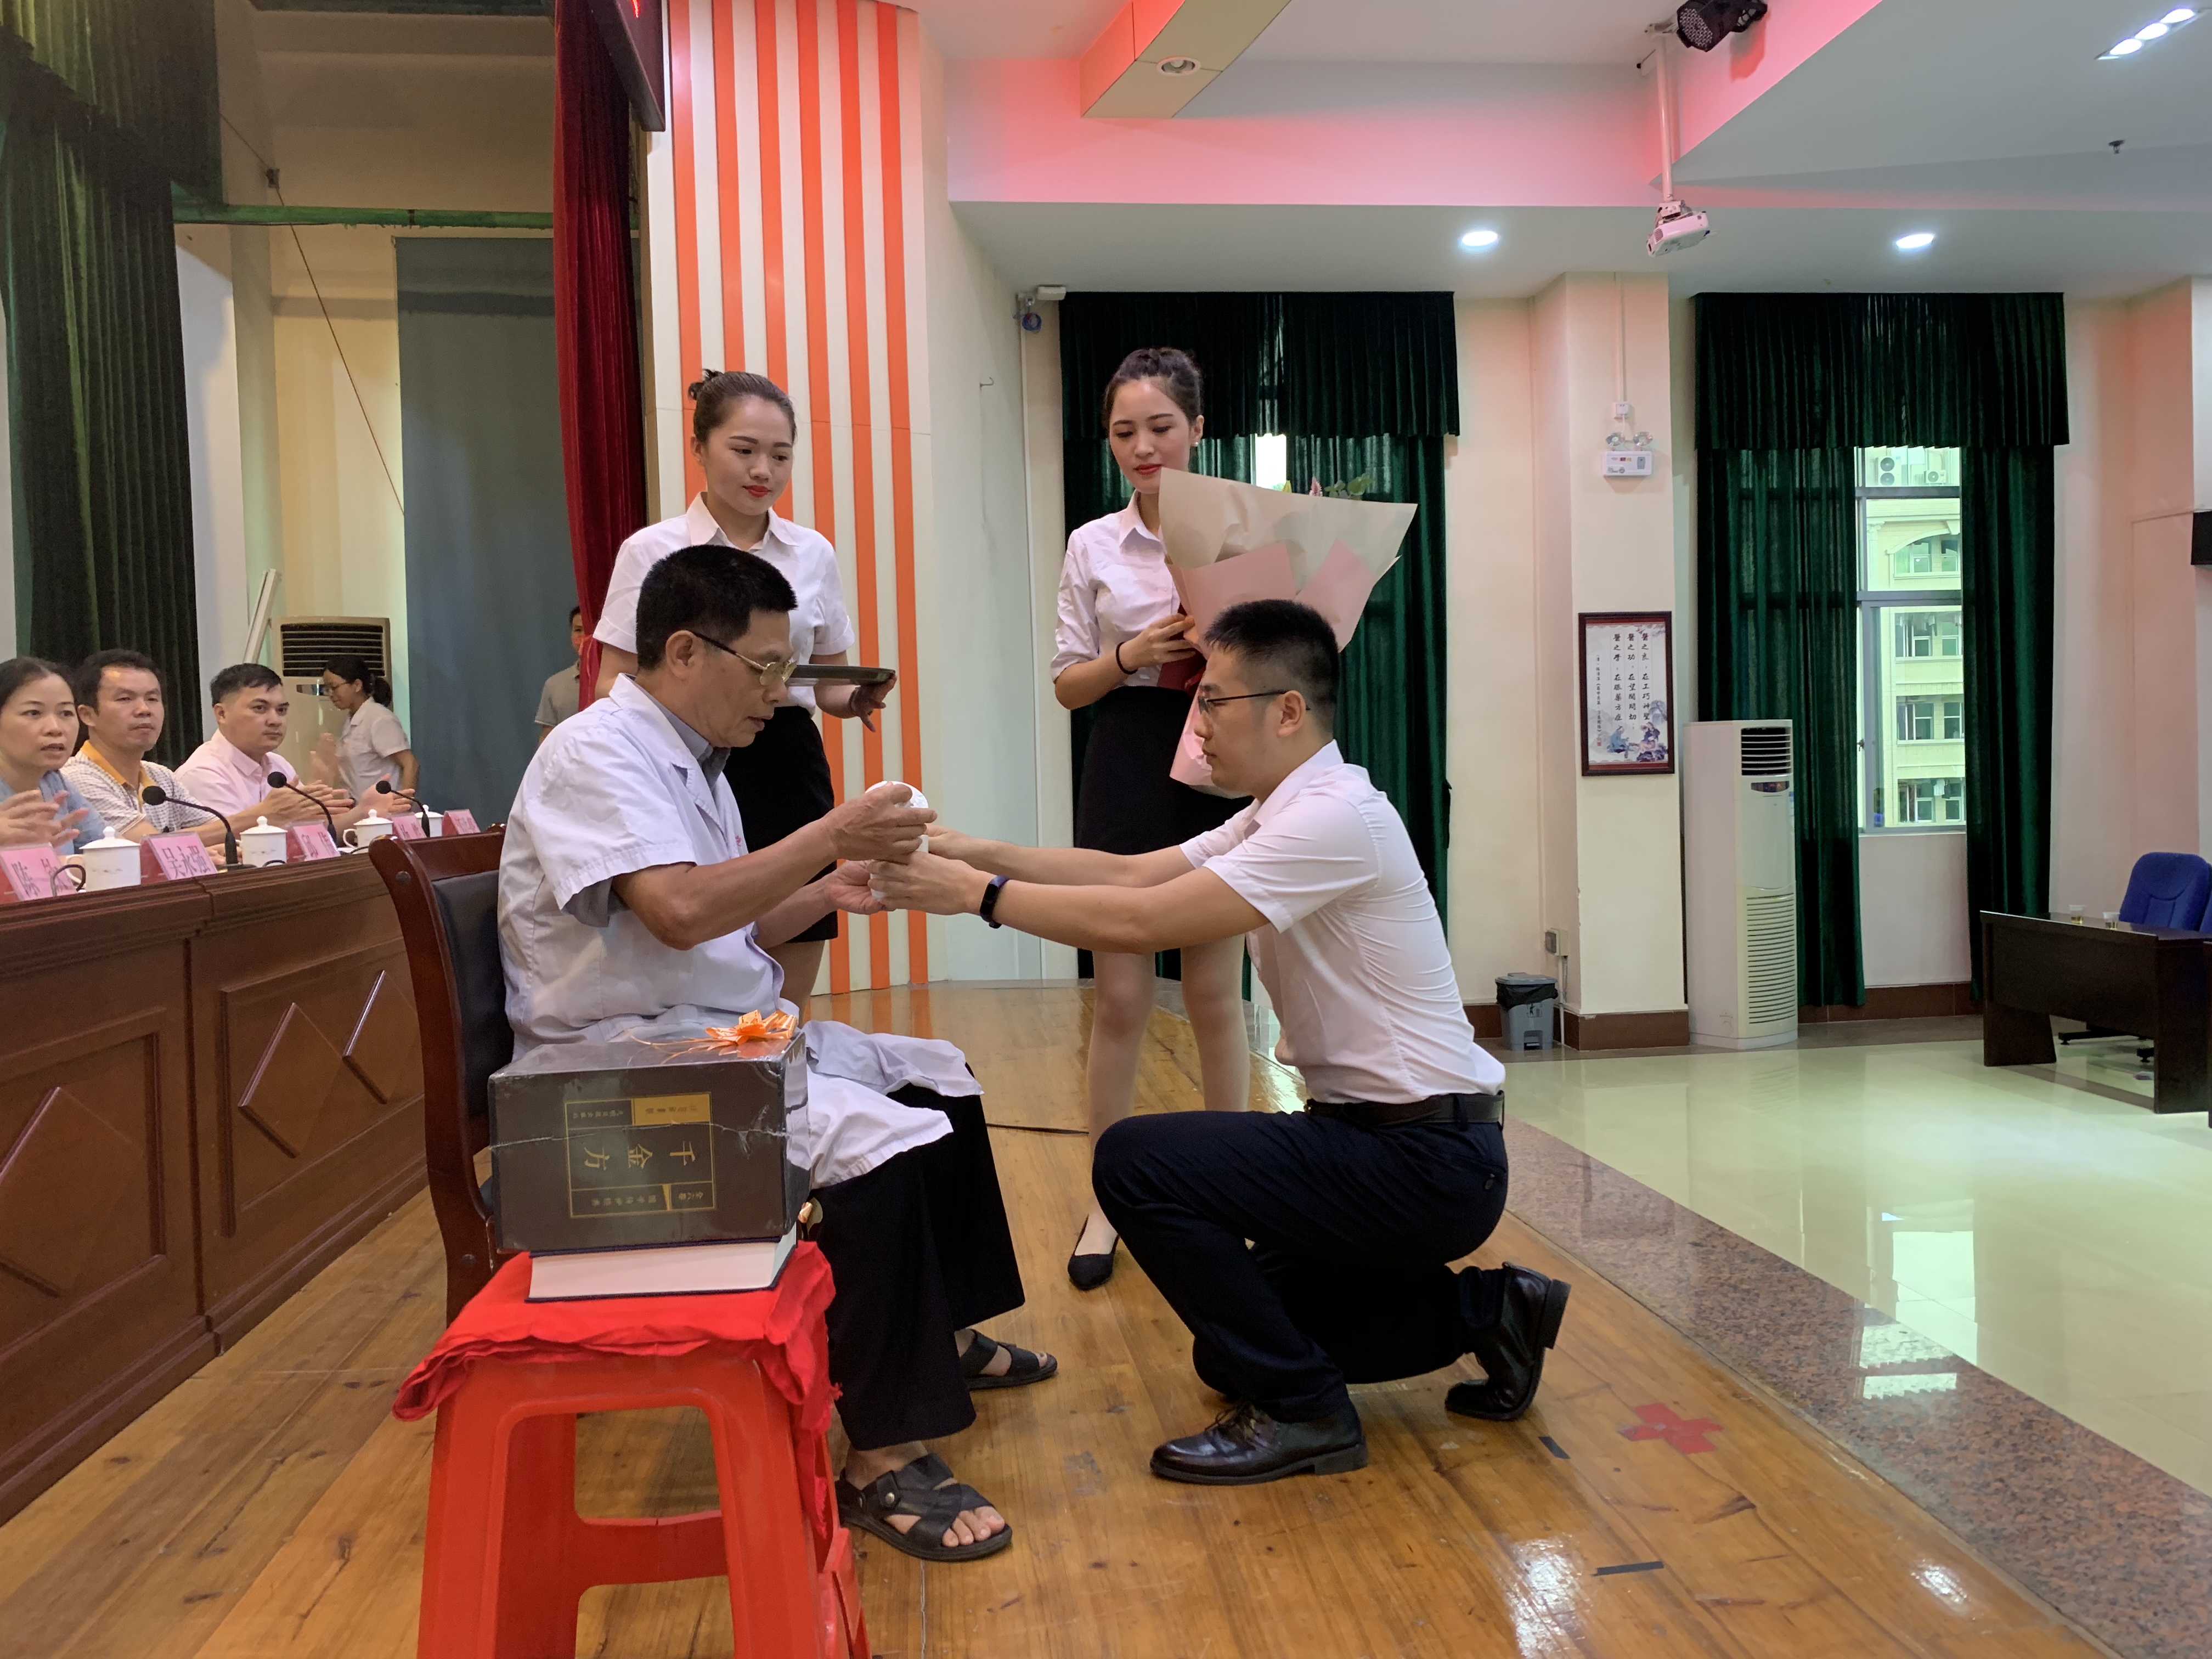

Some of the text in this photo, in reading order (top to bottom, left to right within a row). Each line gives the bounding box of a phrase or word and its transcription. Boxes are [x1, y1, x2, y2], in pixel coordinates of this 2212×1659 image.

[162, 845, 211, 879] 吴永强
[584, 1141, 696, 1171] 千金方
